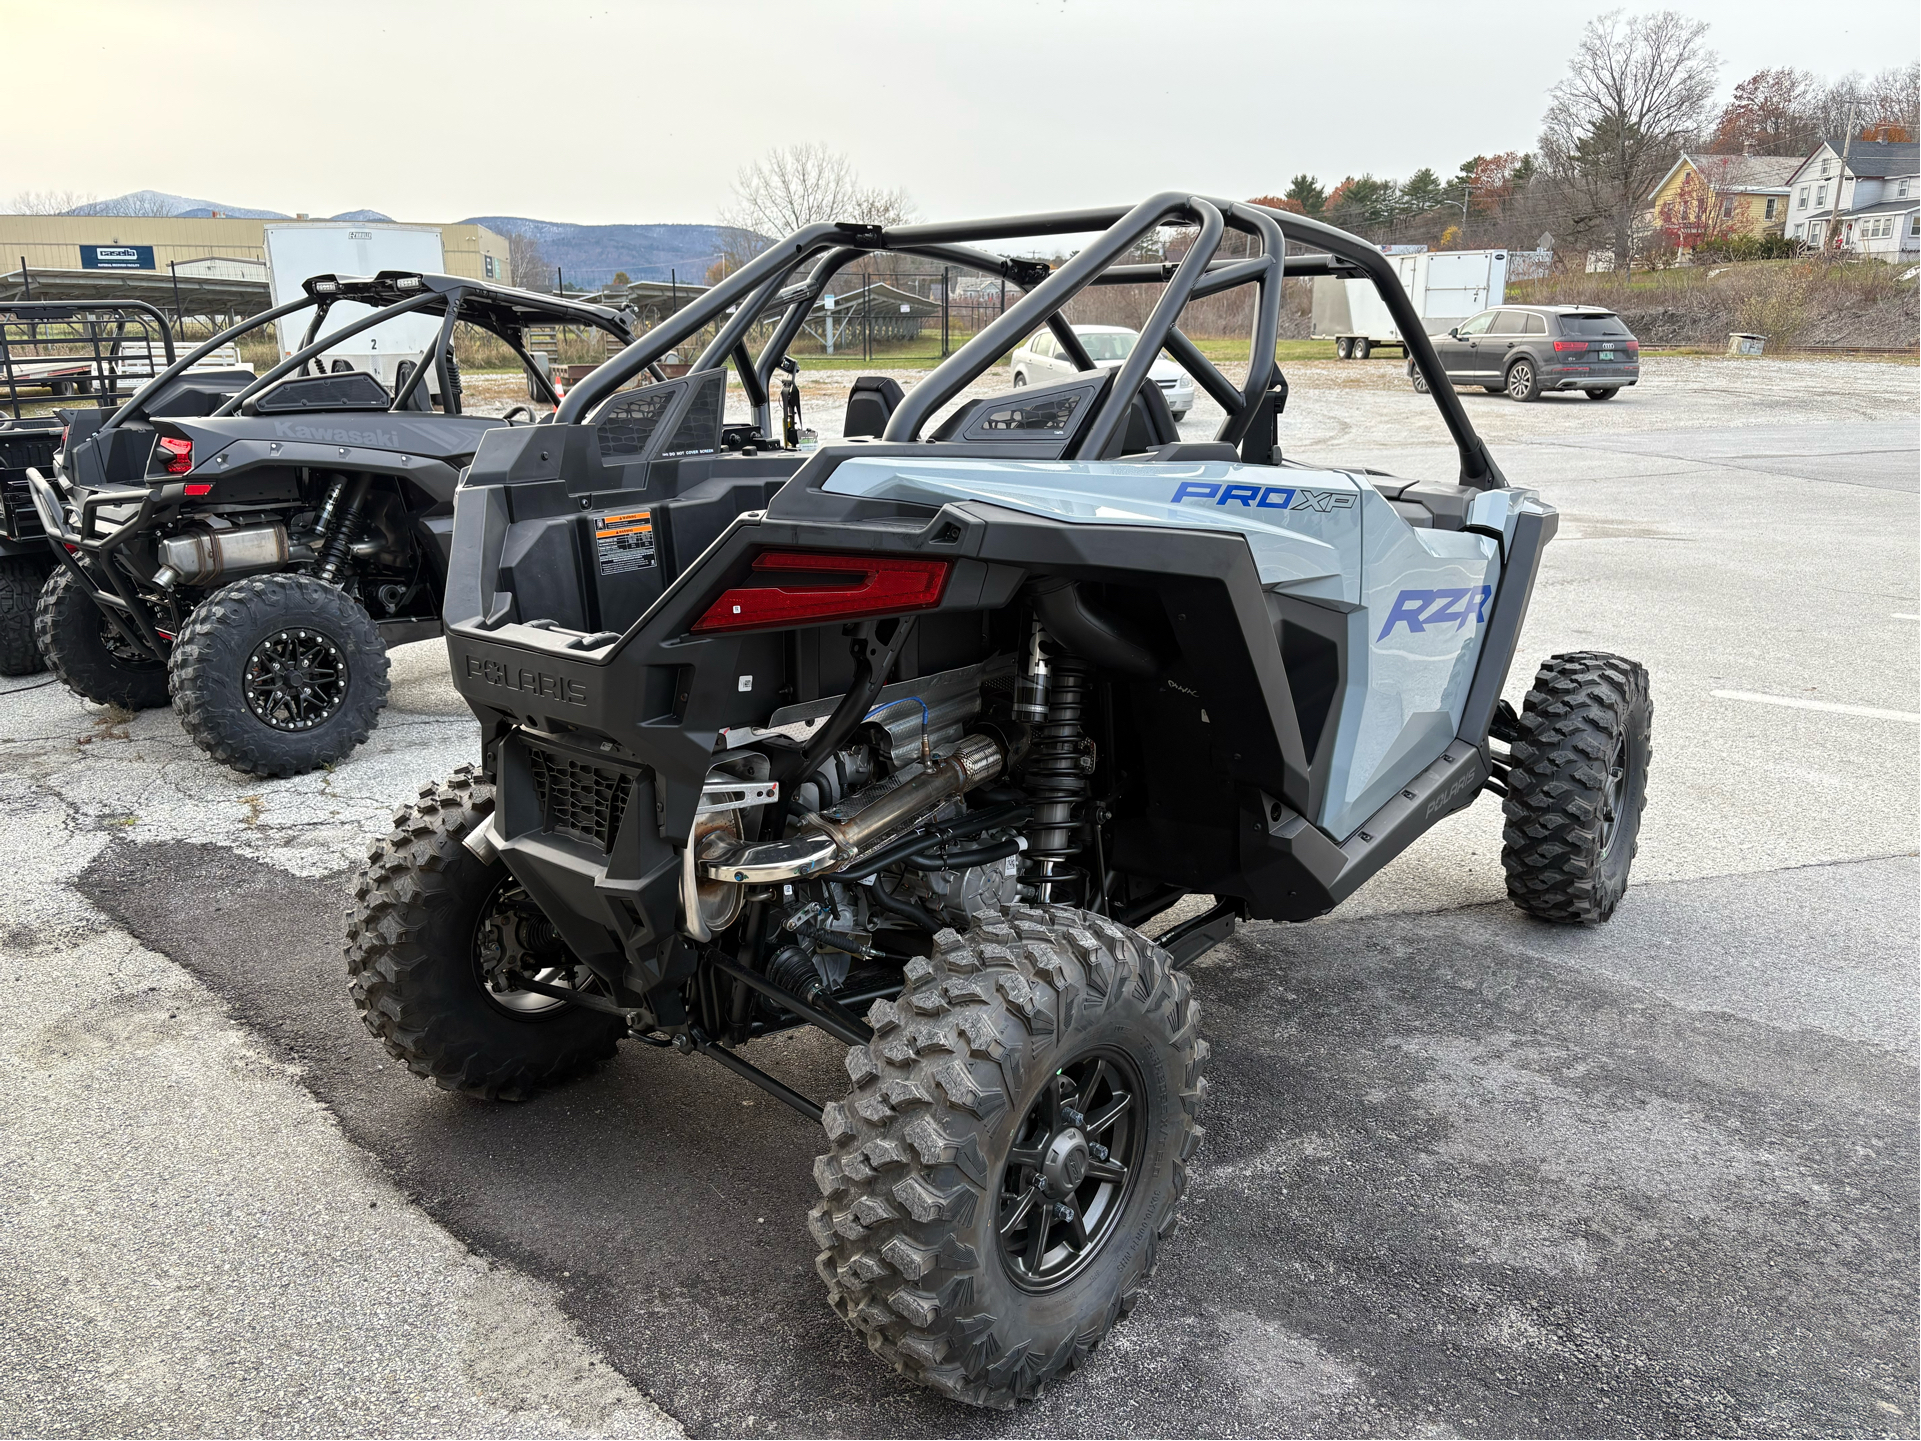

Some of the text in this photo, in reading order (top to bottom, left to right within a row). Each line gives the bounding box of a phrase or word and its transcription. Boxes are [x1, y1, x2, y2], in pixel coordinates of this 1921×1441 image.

[371, 338, 377, 350] 2
[274, 422, 400, 448] Kawasaki
[1170, 482, 1358, 513] PRO XP
[1376, 584, 1492, 644] RZR
[466, 655, 587, 706] POLARIS
[1425, 765, 1476, 820] POLARIS
